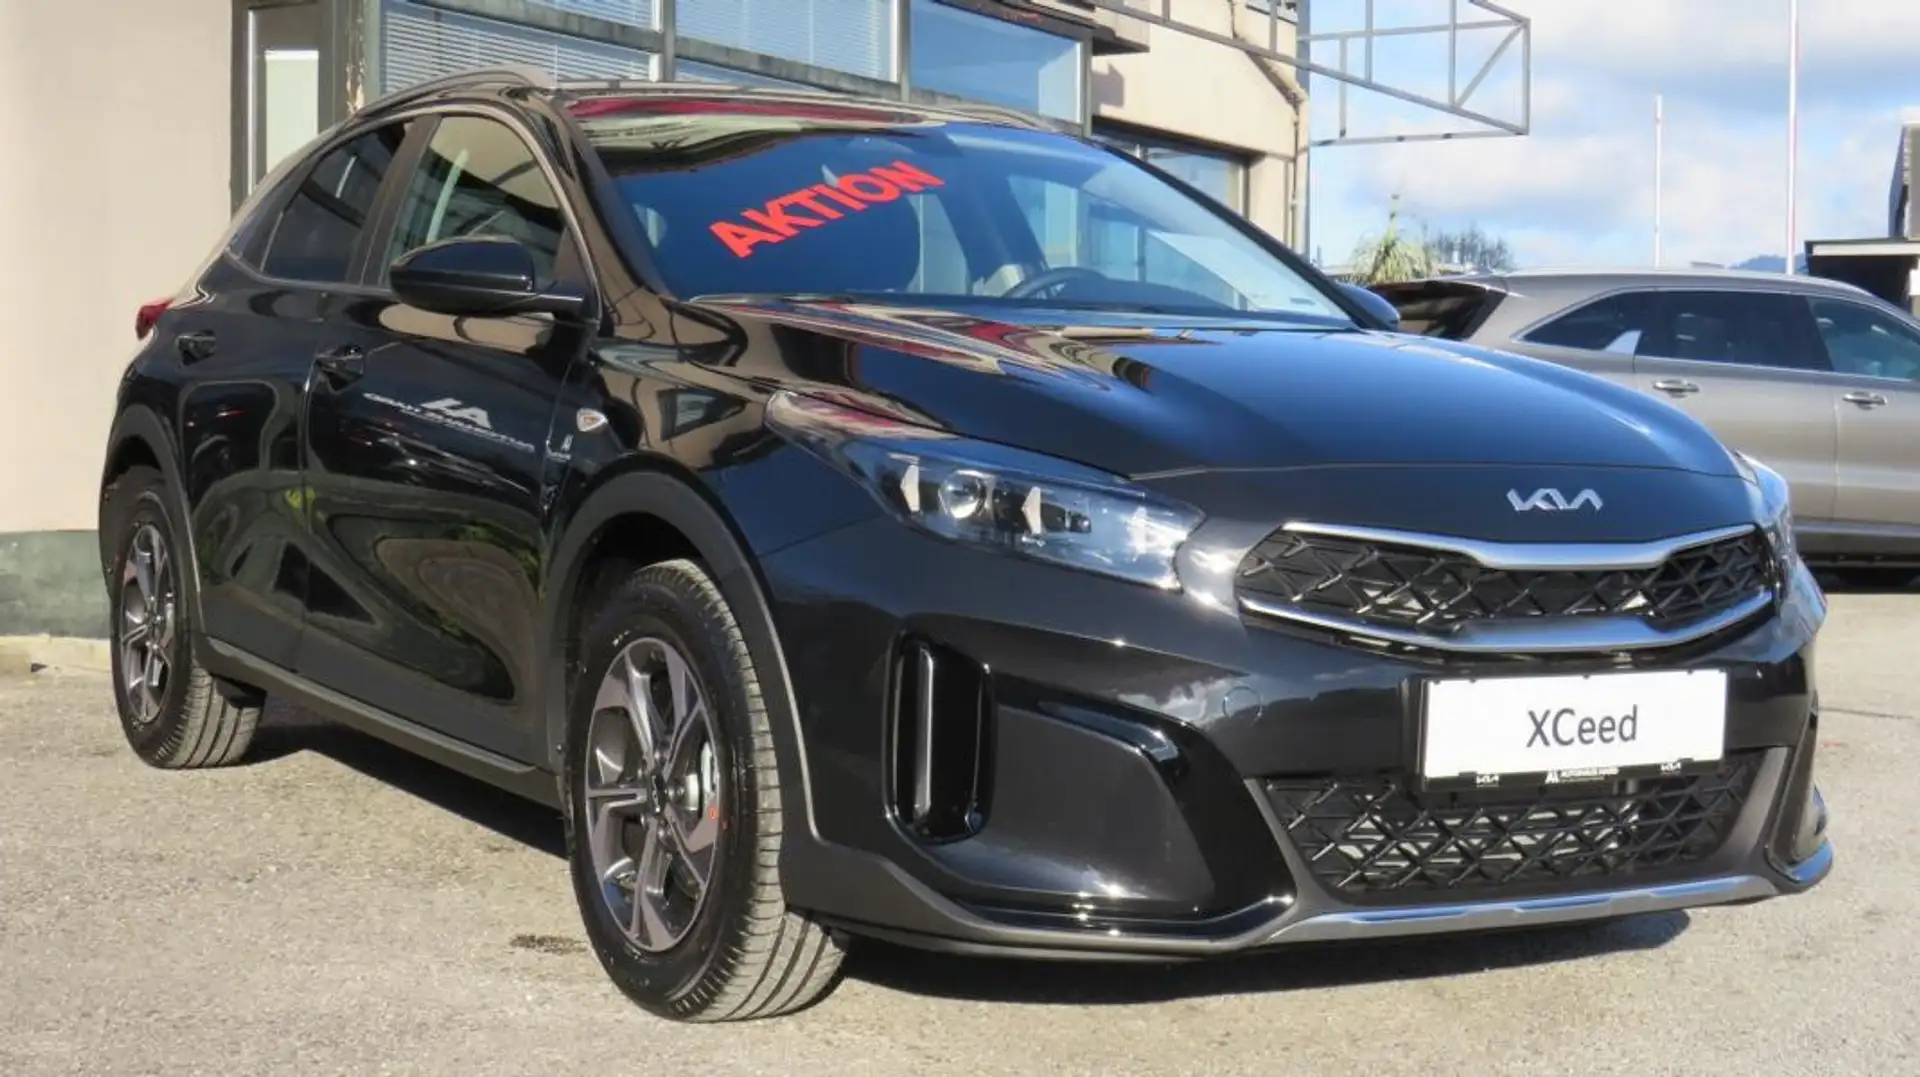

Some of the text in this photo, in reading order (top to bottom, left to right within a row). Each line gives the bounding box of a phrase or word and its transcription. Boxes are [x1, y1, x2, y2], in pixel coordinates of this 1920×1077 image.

[709, 160, 945, 258] AKTION
[1506, 488, 1603, 511] KIA
[1526, 704, 1638, 748] XCeed
